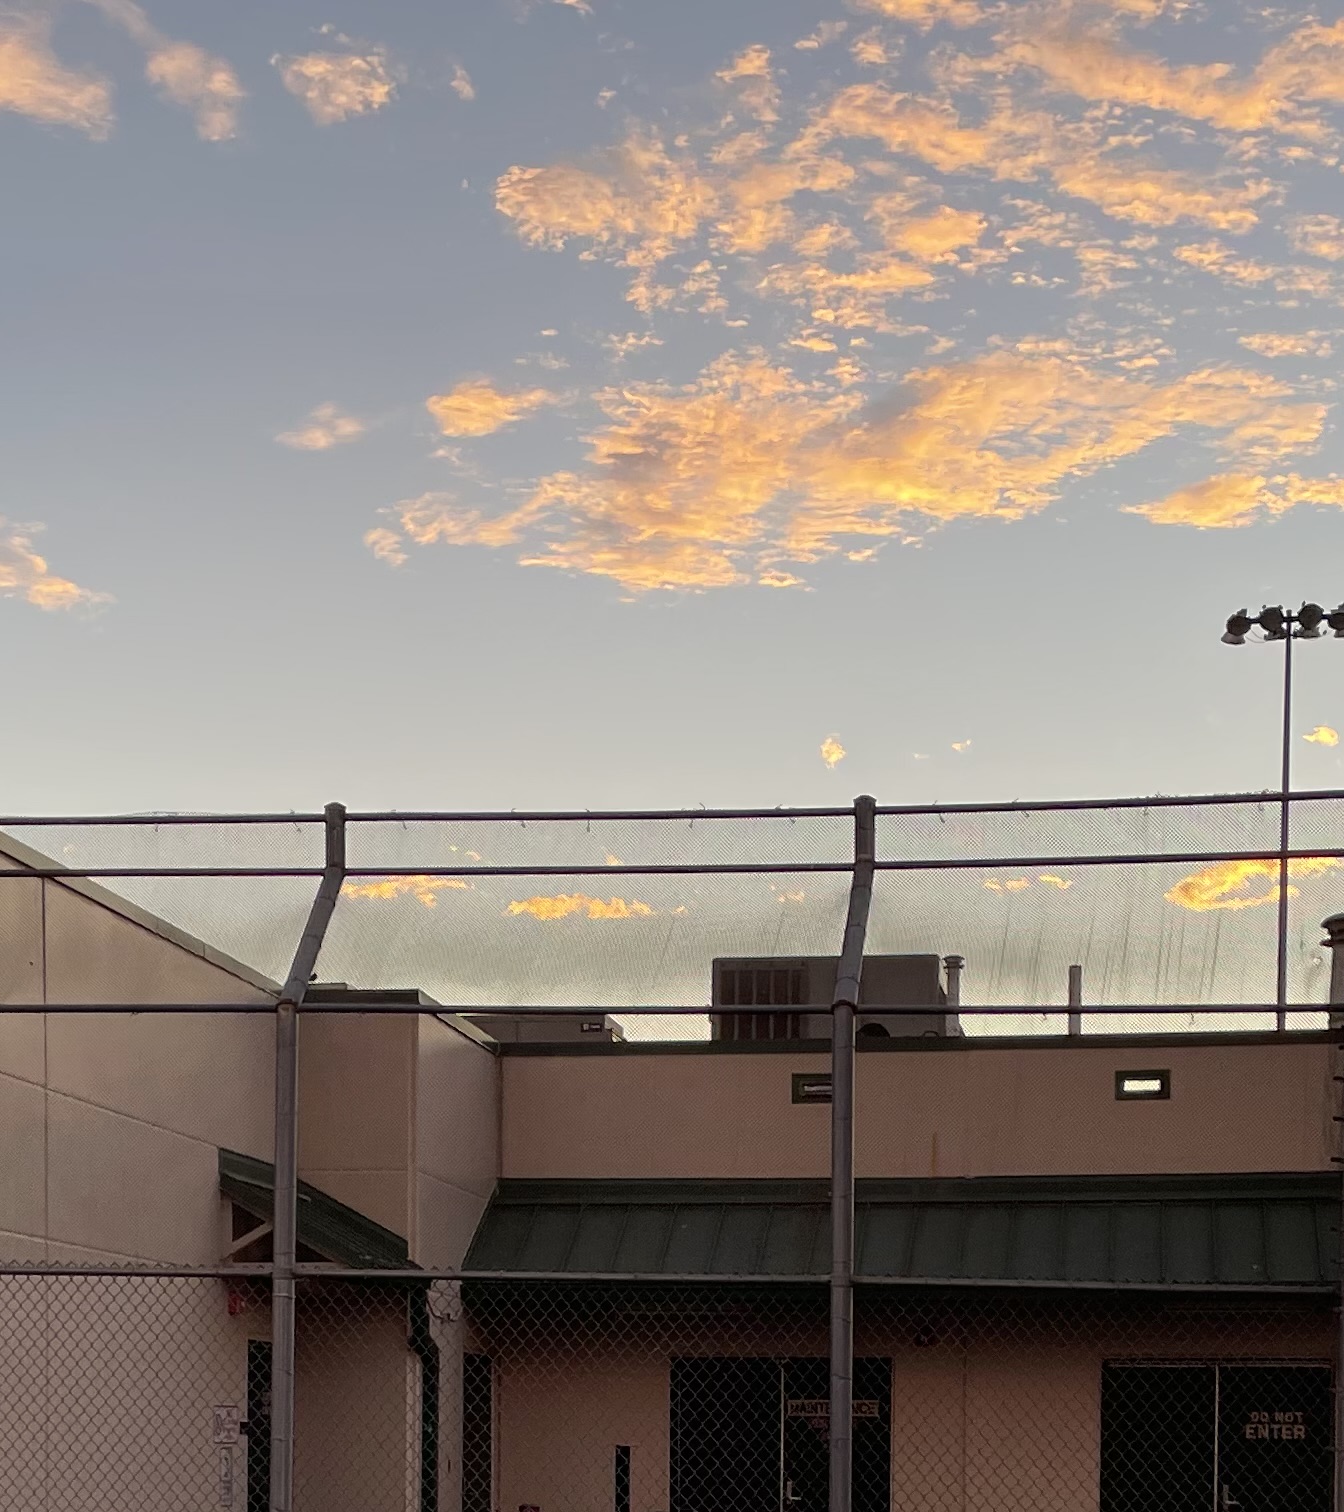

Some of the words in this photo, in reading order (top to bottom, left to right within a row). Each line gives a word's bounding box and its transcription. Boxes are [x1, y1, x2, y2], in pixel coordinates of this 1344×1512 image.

[1250, 1411, 1269, 1422] DO
[1274, 1411, 1304, 1423] NOT
[1245, 1424, 1306, 1440] ENTER
